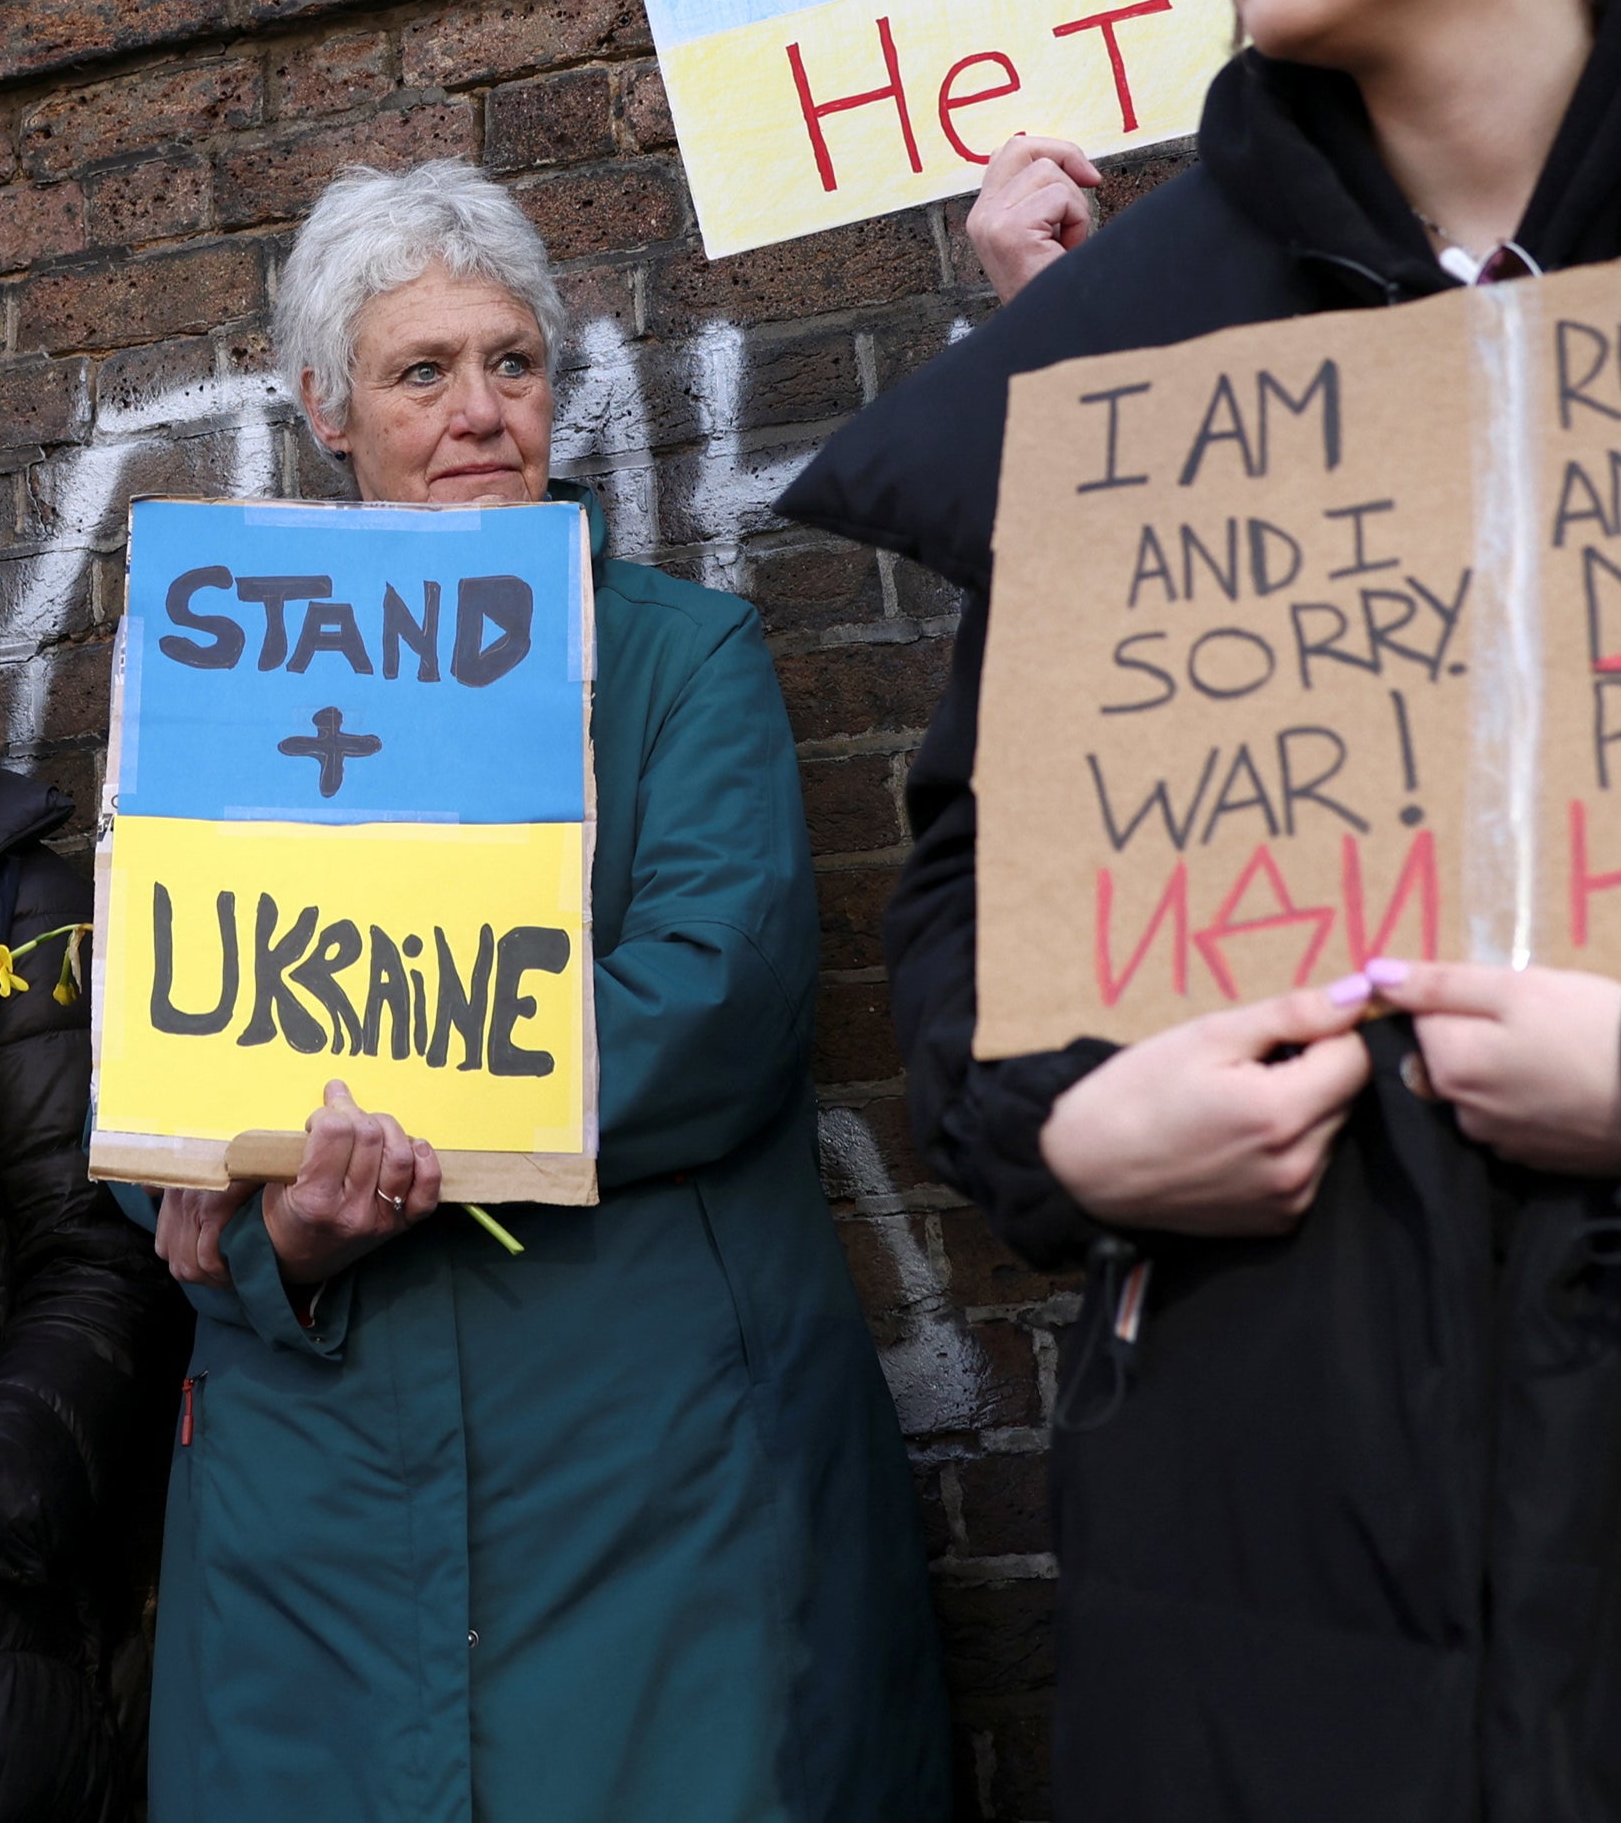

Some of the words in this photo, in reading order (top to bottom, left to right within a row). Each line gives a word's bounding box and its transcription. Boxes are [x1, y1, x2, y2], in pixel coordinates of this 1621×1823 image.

[1075, 382, 1152, 494] I
[1178, 357, 1341, 486] AM
[1127, 516, 1303, 609] AND
[1323, 499, 1400, 580] I
[158, 564, 535, 688] STAND
[1099, 567, 1474, 715] SORRY.
[1086, 689, 1427, 853] WAR!
[1095, 828, 1441, 1008] ИДИ
